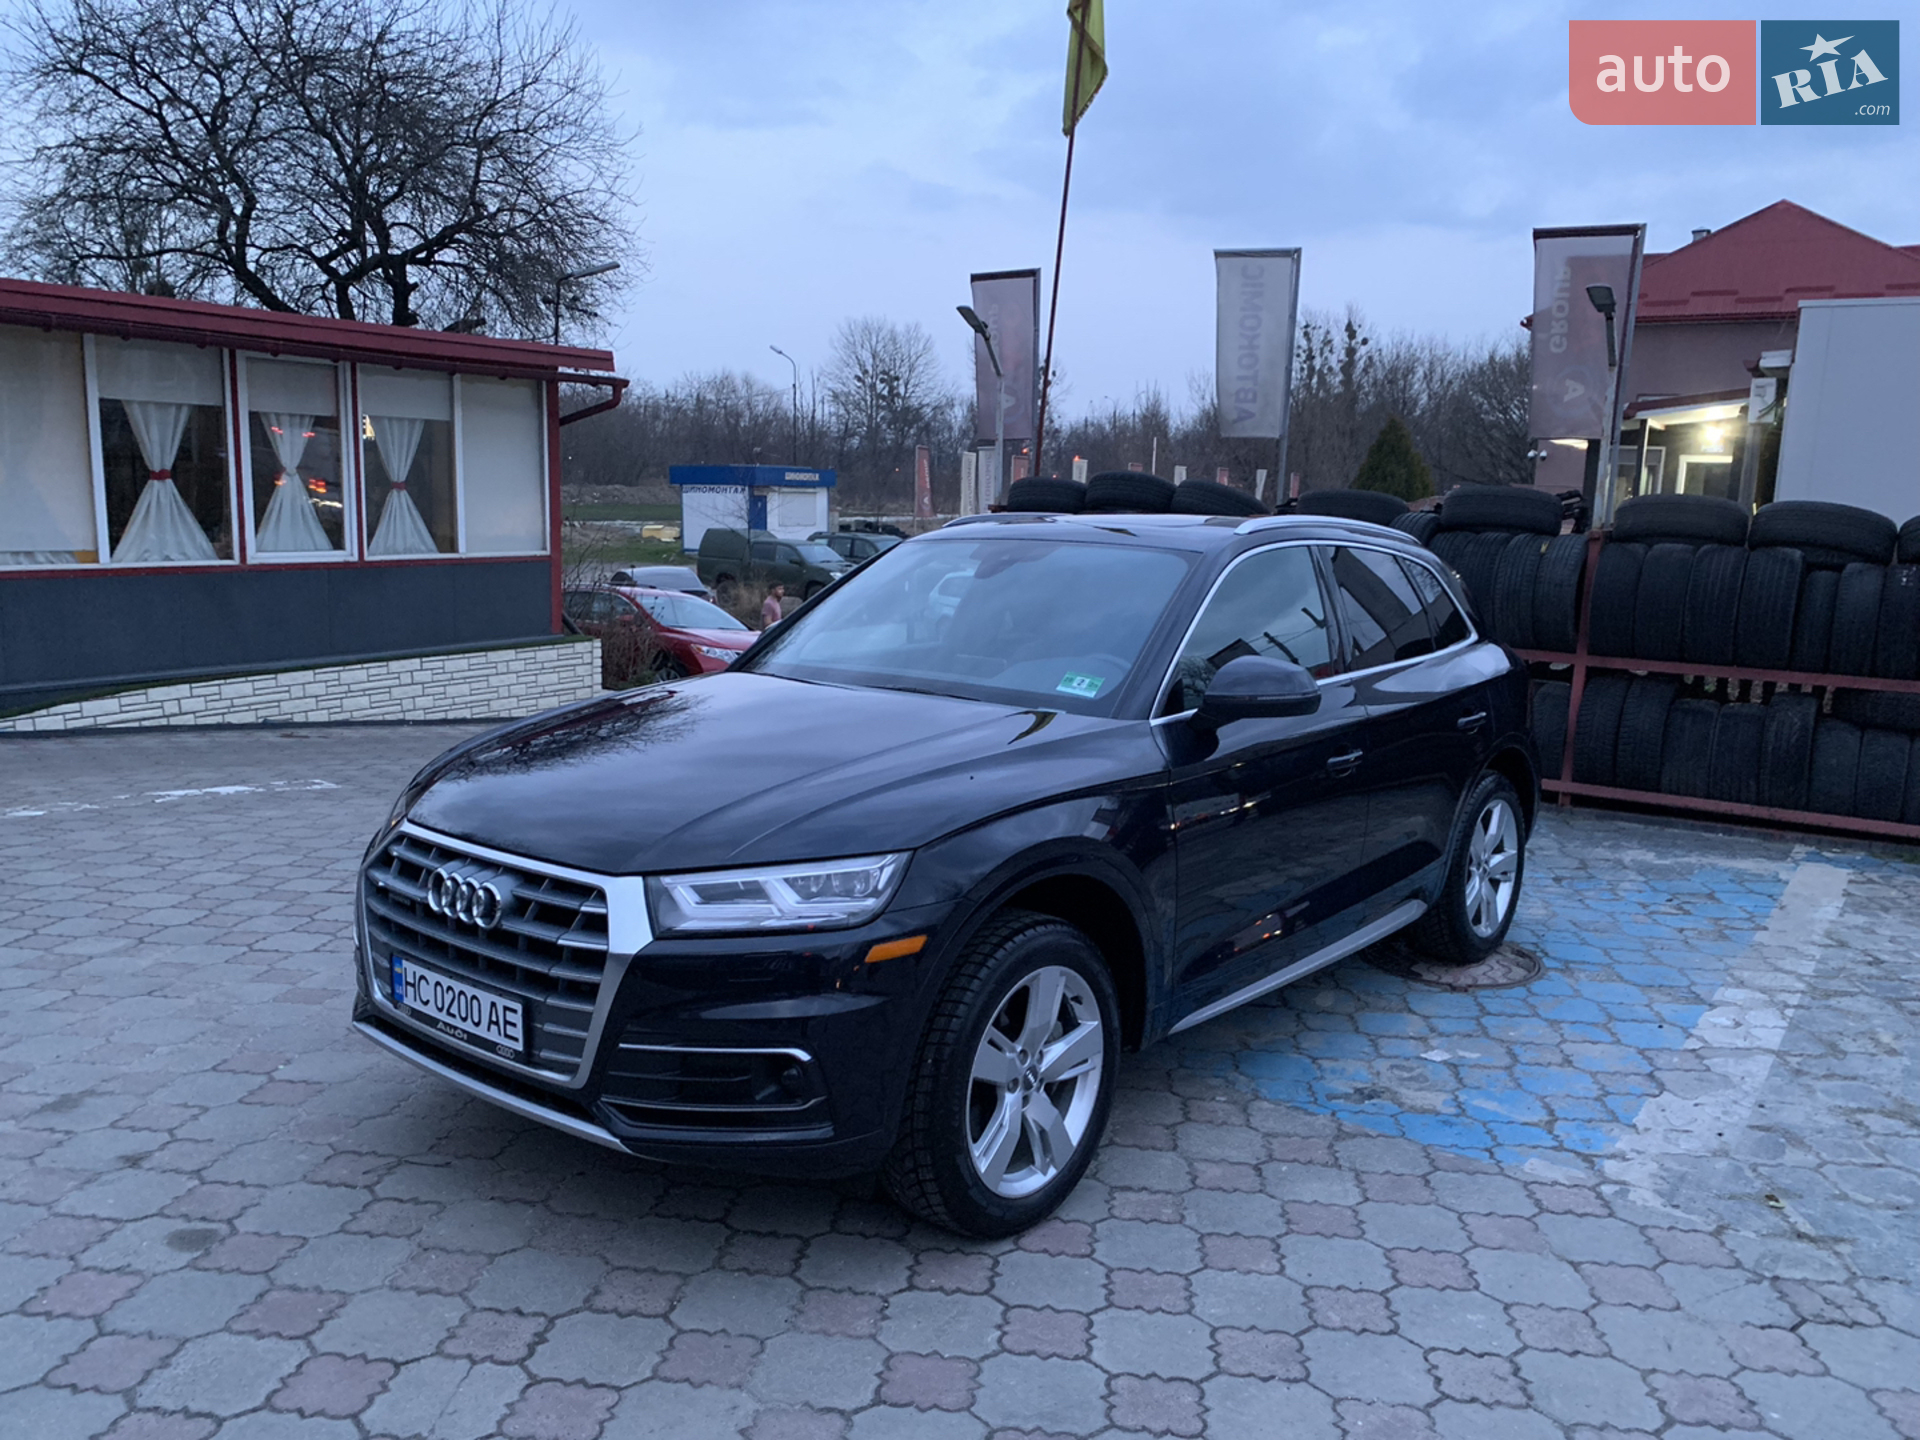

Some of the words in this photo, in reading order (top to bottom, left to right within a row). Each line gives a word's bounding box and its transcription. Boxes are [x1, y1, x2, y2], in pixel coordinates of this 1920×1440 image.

[404, 967, 430, 1007] HC
[434, 981, 482, 1028] 0200
[487, 1001, 520, 1043] AE
